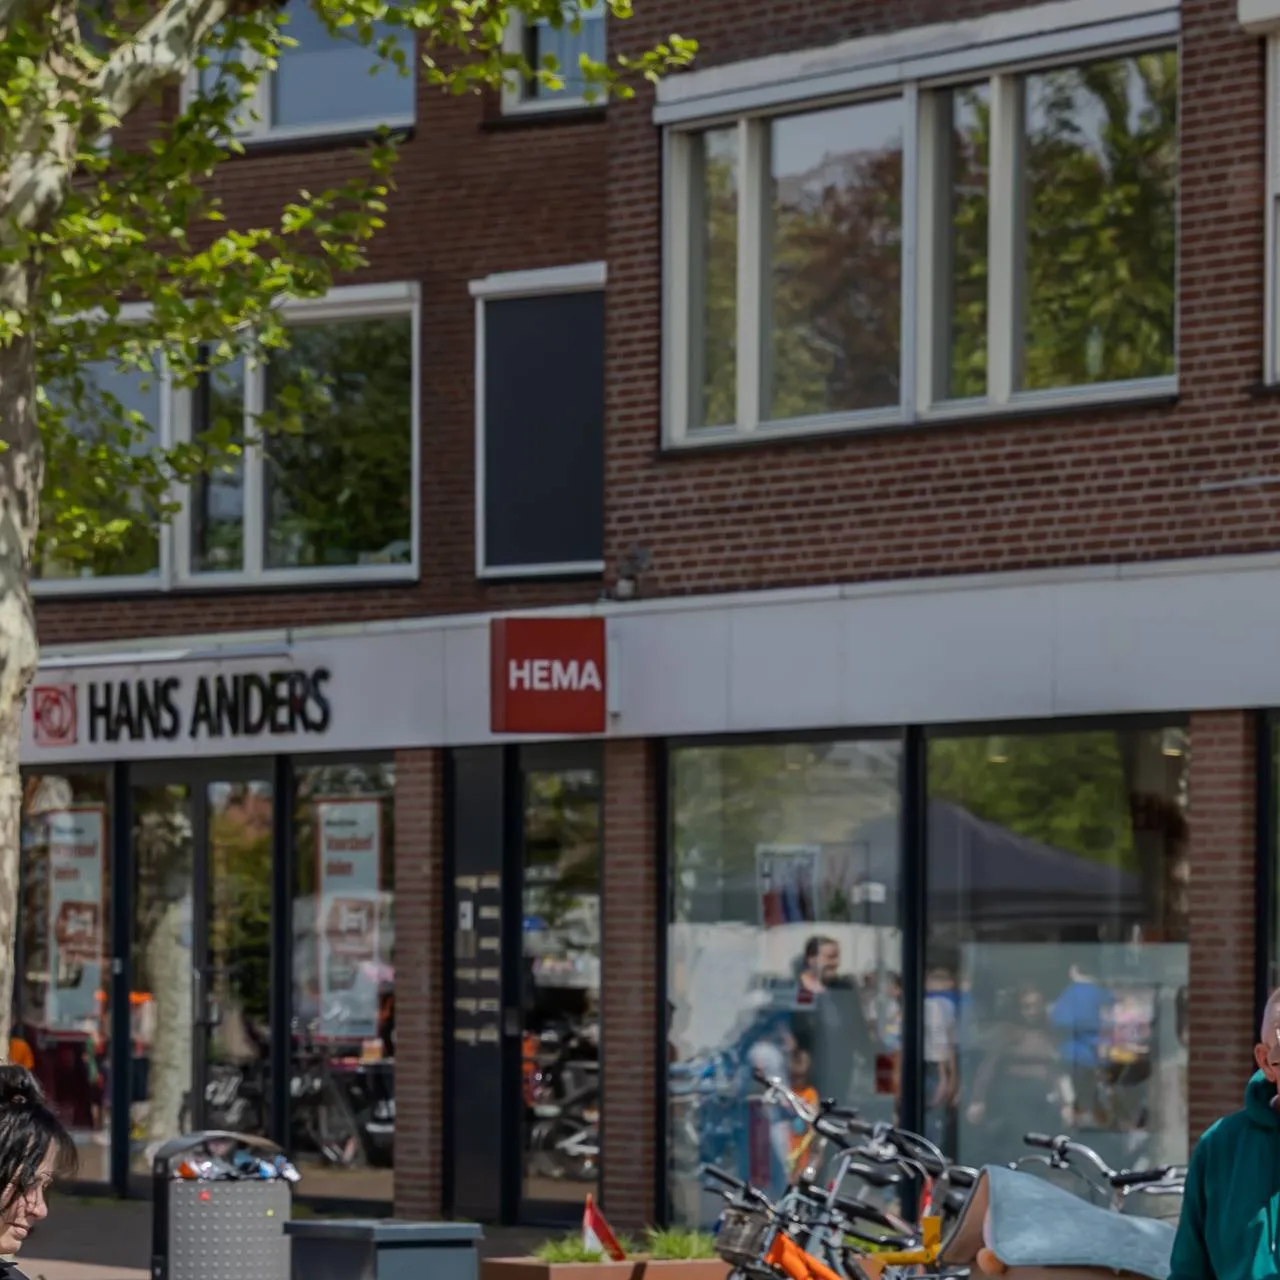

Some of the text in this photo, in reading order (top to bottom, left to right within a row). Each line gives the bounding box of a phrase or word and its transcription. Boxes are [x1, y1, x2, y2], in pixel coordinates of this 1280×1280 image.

[508, 658, 603, 692] HEMA
[88, 667, 332, 744] HANS ANDERS
